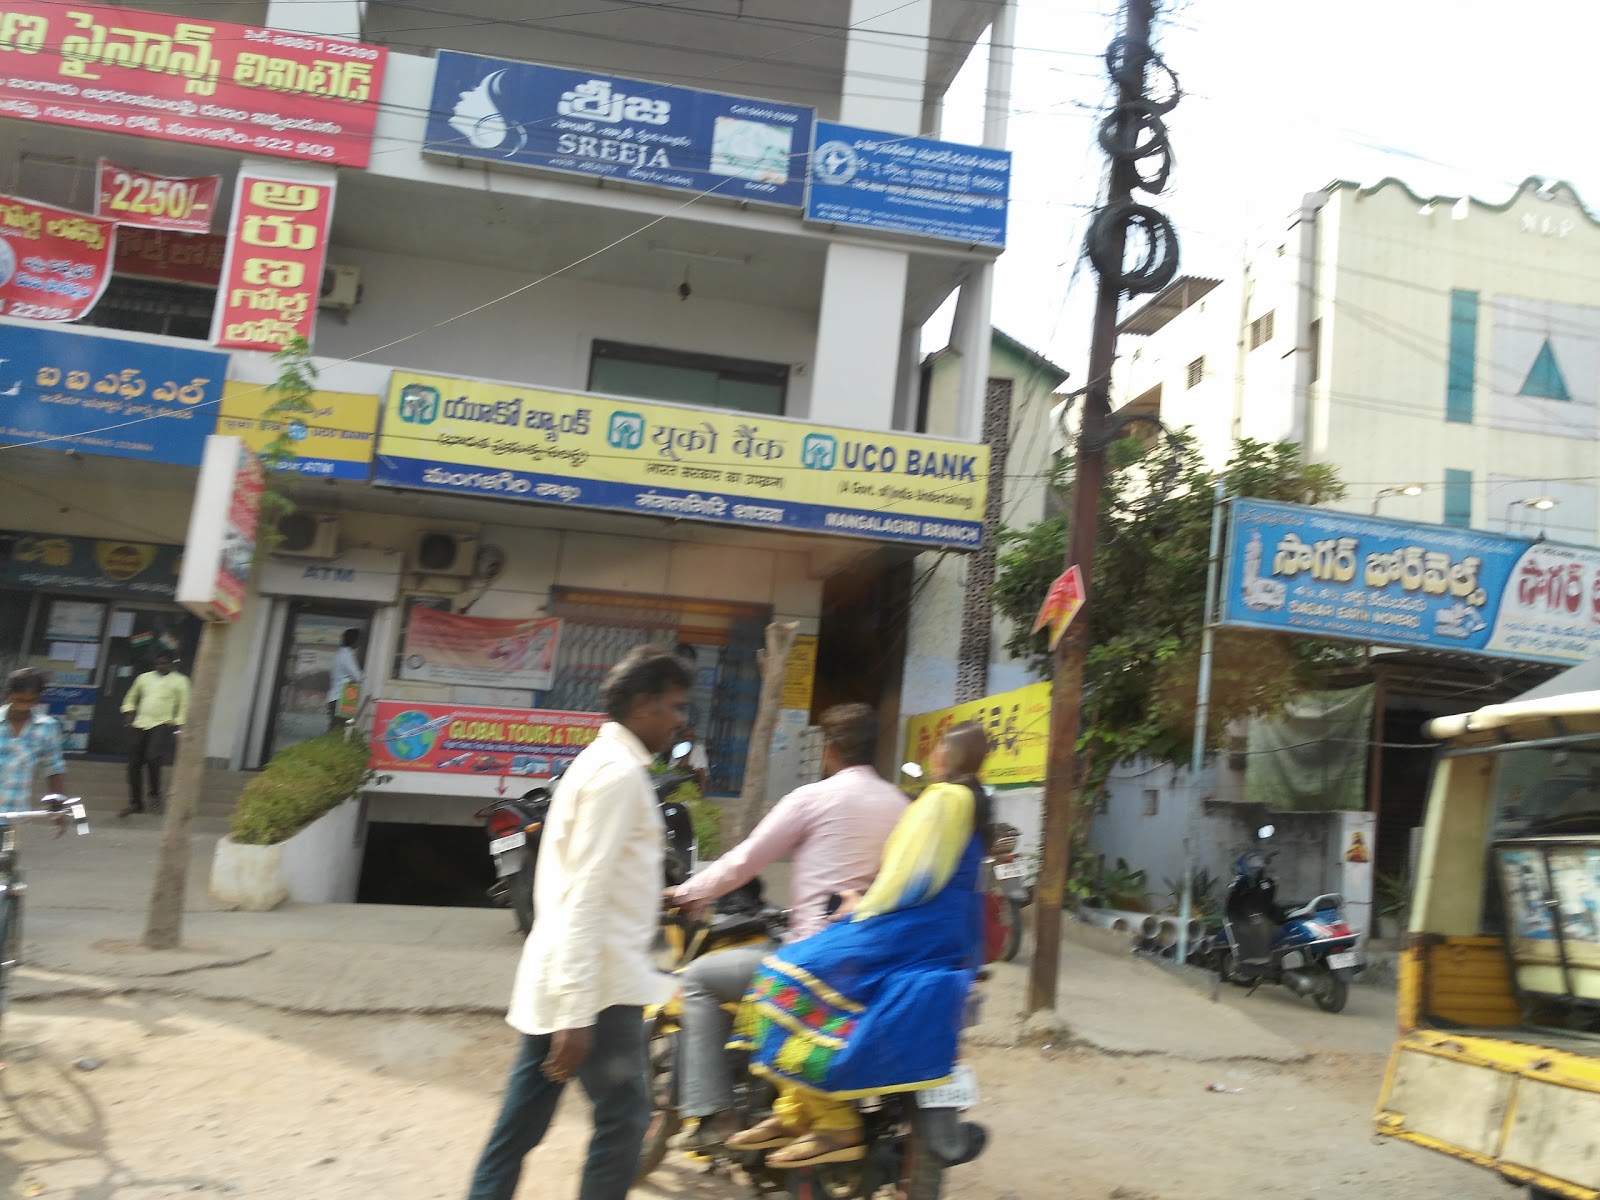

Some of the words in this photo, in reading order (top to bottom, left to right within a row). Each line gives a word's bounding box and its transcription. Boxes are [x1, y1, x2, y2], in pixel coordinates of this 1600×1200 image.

[233, 52, 373, 102] లిమిటెడ్
[557, 79, 671, 125] శ్రీజ
[295, 141, 335, 157] 503
[112, 173, 208, 219] 2250/-
[36, 366, 61, 388] ఐ
[65, 369, 91, 391] ఐ
[94, 368, 147, 399] ఎఫ్
[152, 379, 210, 405] ఎల్
[443, 396, 523, 427] యూకో
[524, 408, 592, 442] బ్యాంక్
[650, 421, 719, 461] यूको
[844, 441, 897, 473] UCO
[906, 449, 978, 482] BANK
[824, 512, 922, 536] MANGALAGIRI
[922, 521, 979, 542] BRANCH
[303, 564, 356, 583] ATM
[1273, 532, 1358, 582] సాగర్
[1519, 560, 1583, 613] సాగర్
[450, 720, 505, 741] GLOBAL
[508, 723, 551, 743] TOURS
[553, 728, 563, 744] &
